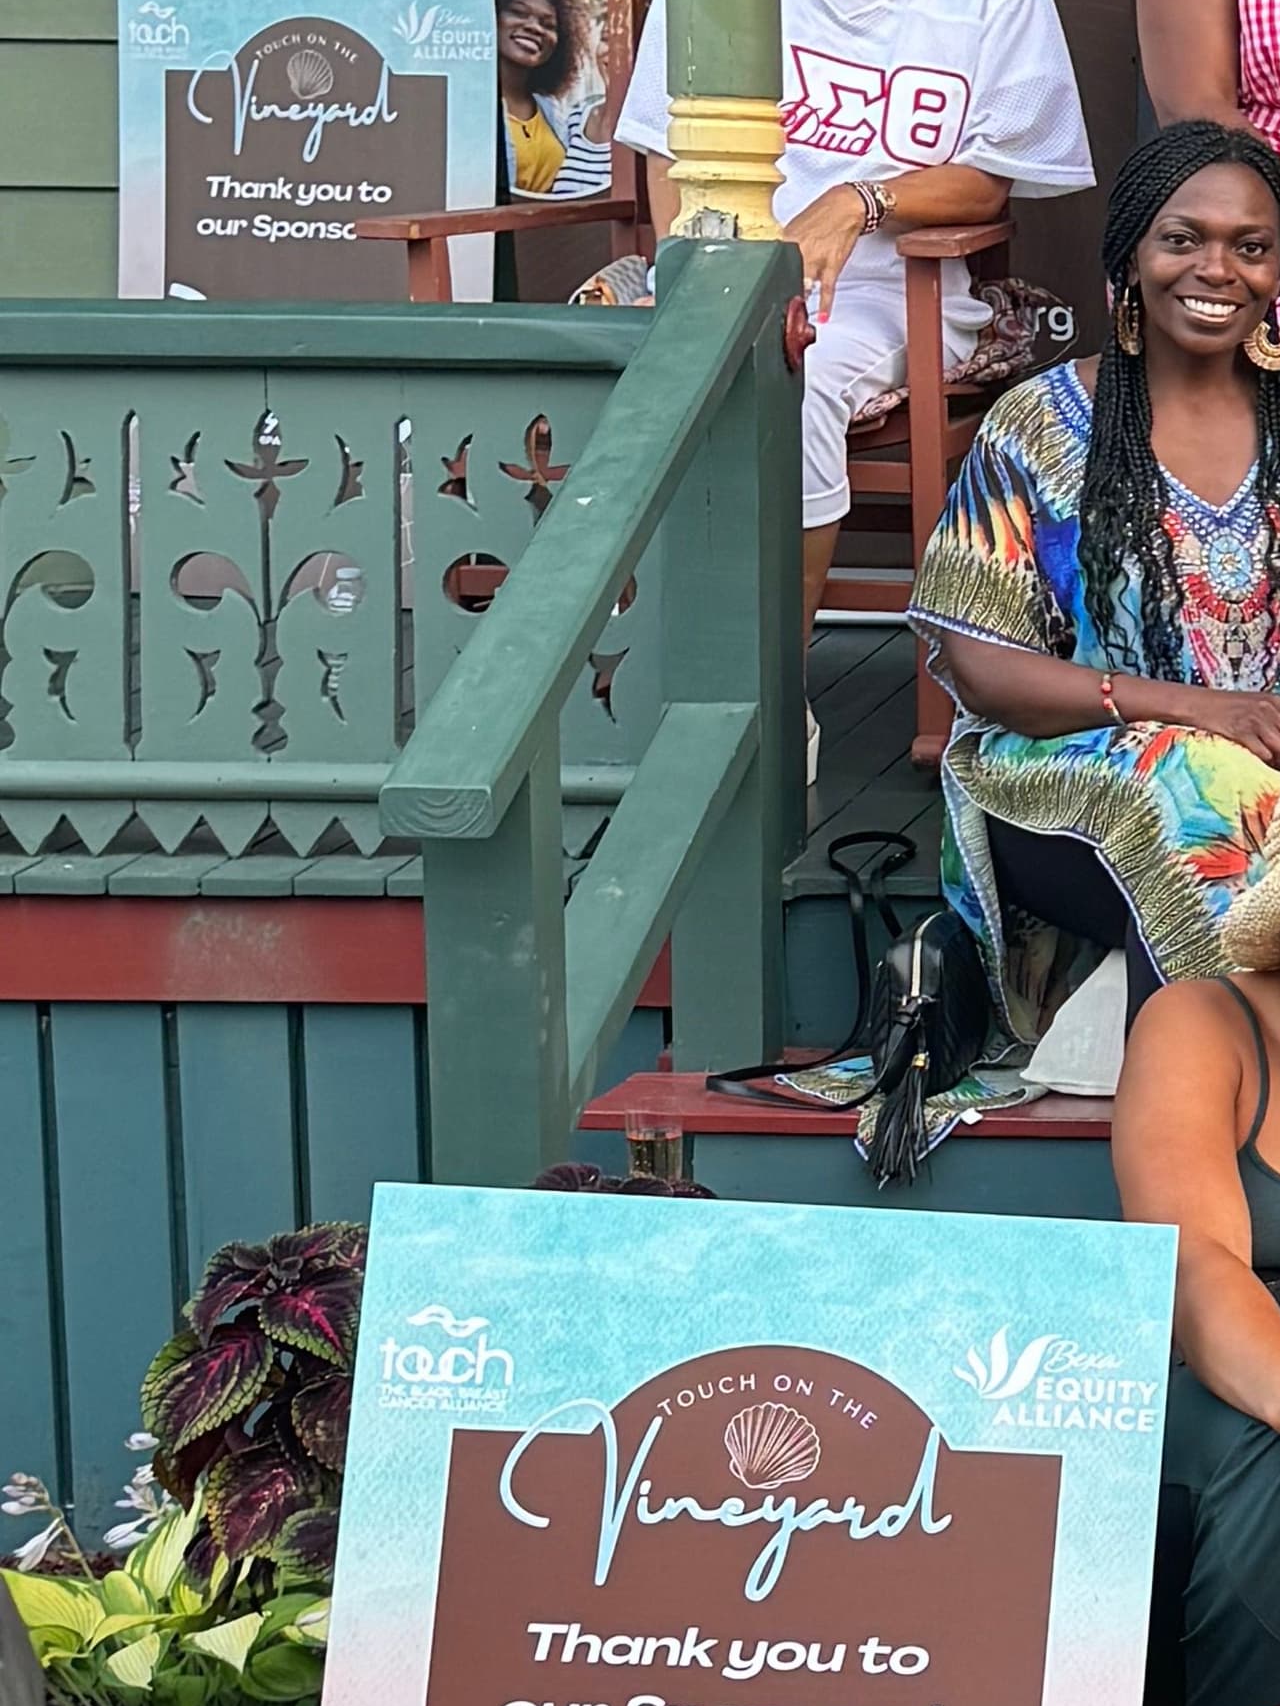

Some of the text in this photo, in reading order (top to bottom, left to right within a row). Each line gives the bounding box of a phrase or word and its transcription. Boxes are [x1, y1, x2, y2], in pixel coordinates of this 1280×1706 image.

[255, 33, 359, 64] TOUCH ON THE
[432, 29, 493, 44] EQUITY
[413, 46, 494, 61] ALLIANCE
[187, 50, 398, 163] Vineyard
[205, 175, 392, 206] Thank you to
[196, 217, 248, 236] our
[379, 1333, 514, 1385] touch
[1043, 1340, 1123, 1373] Bexa
[657, 1373, 879, 1430] TOUCH ON THE
[1035, 1376, 1160, 1405] EQUITY
[992, 1402, 1160, 1432] ALLIANCE
[499, 1397, 953, 1602] Vineyard
[526, 1622, 930, 1680] Thank you to
